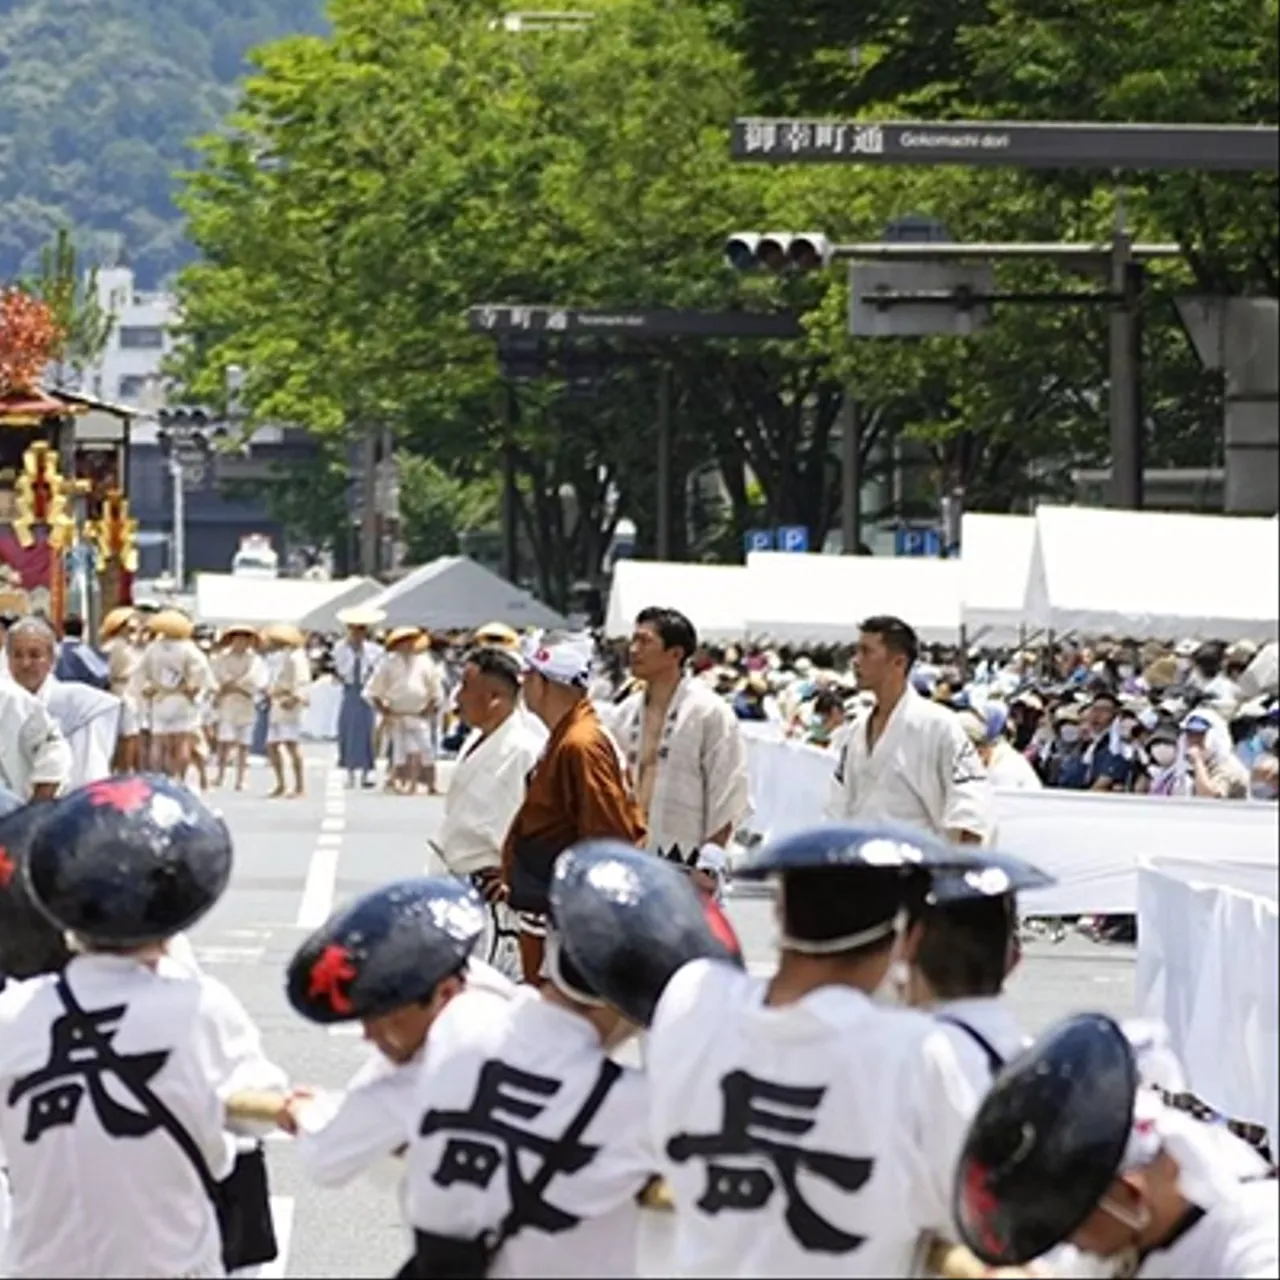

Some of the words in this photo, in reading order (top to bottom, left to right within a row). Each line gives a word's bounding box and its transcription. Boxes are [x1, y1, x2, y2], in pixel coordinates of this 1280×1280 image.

[744, 122, 884, 153] 御幸町通
[666, 1070, 874, 1254] 長
